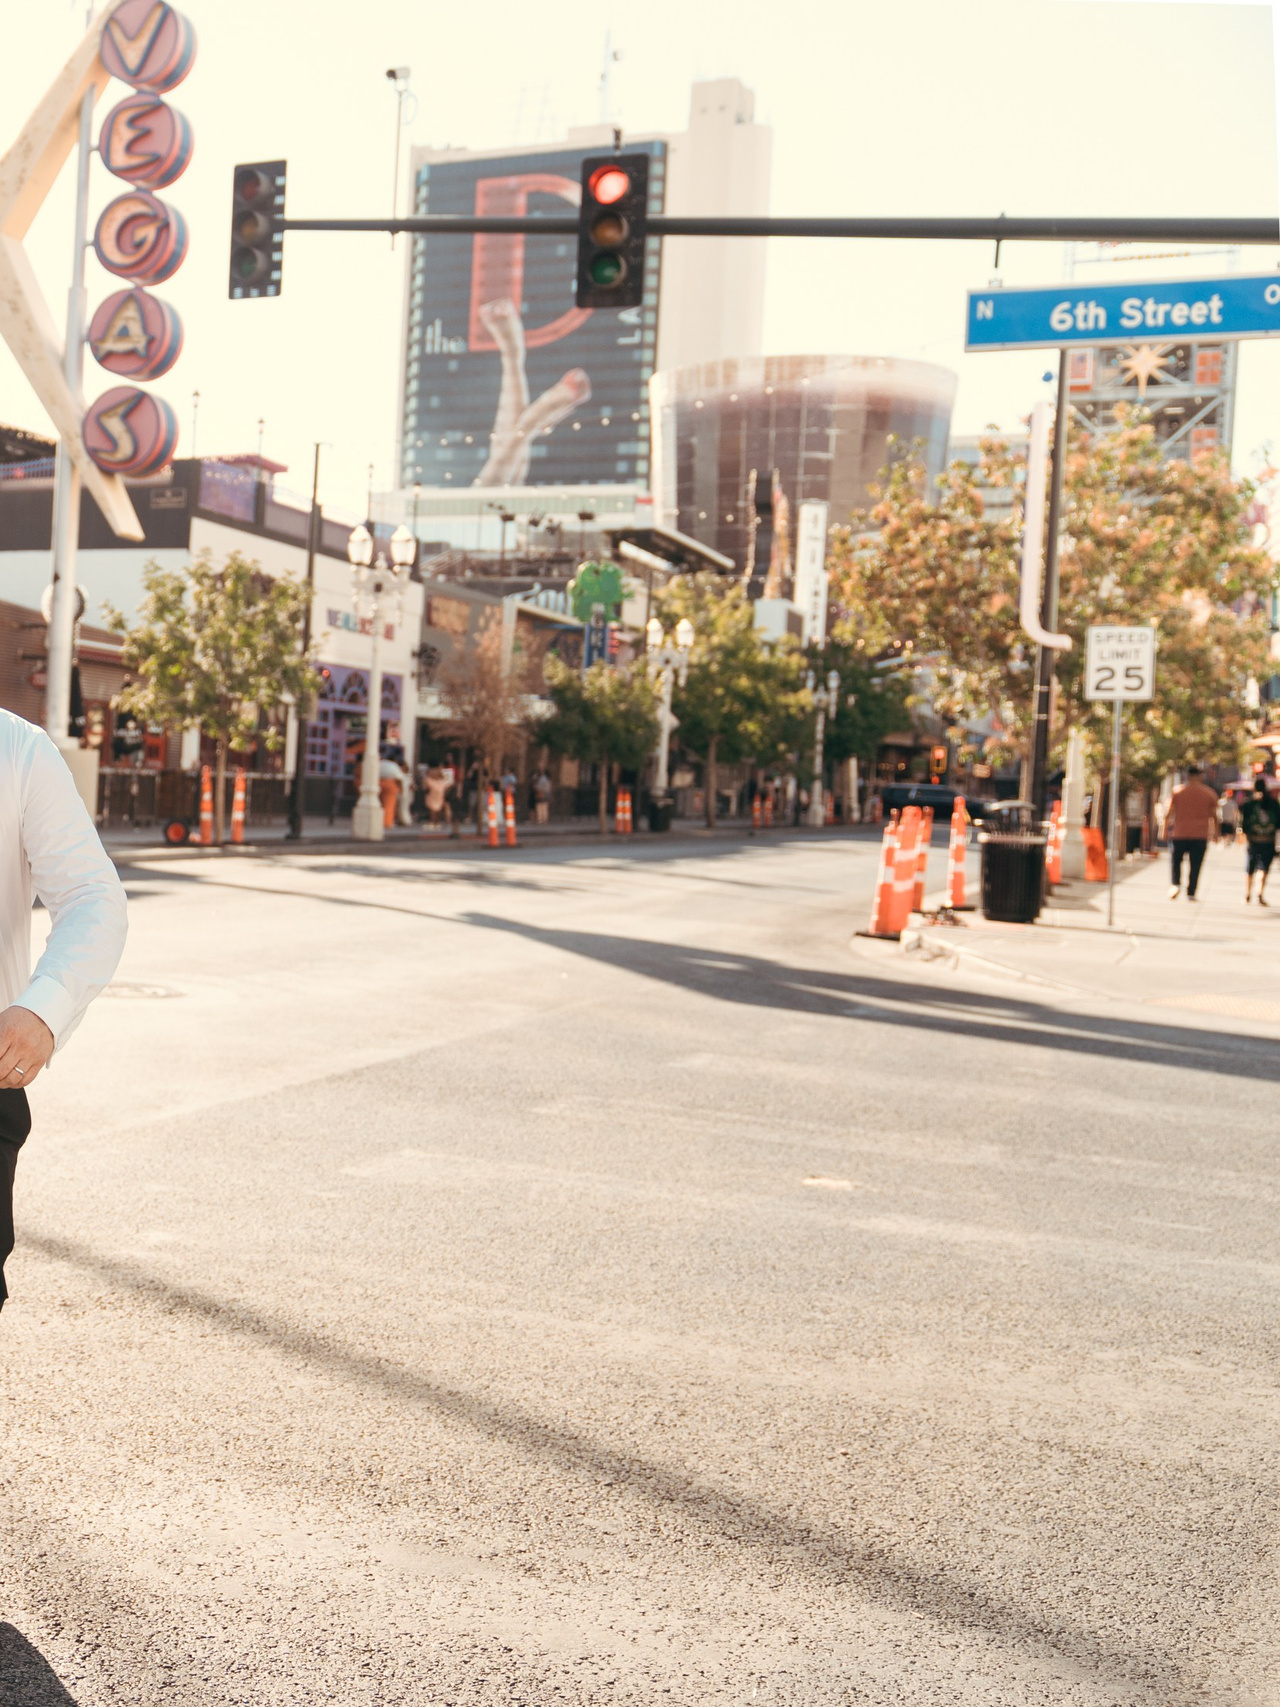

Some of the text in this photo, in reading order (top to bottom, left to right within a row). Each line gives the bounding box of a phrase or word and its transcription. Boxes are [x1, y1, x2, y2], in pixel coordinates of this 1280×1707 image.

[87, 0, 170, 464] VEGAS
[976, 301, 994, 320] N
[1049, 300, 1107, 333] 6th
[1119, 293, 1224, 329] Street
[425, 318, 467, 354] the
[1095, 632, 1149, 644] SPEED
[1099, 648, 1141, 660] LIMIT
[1095, 666, 1145, 691] 25
